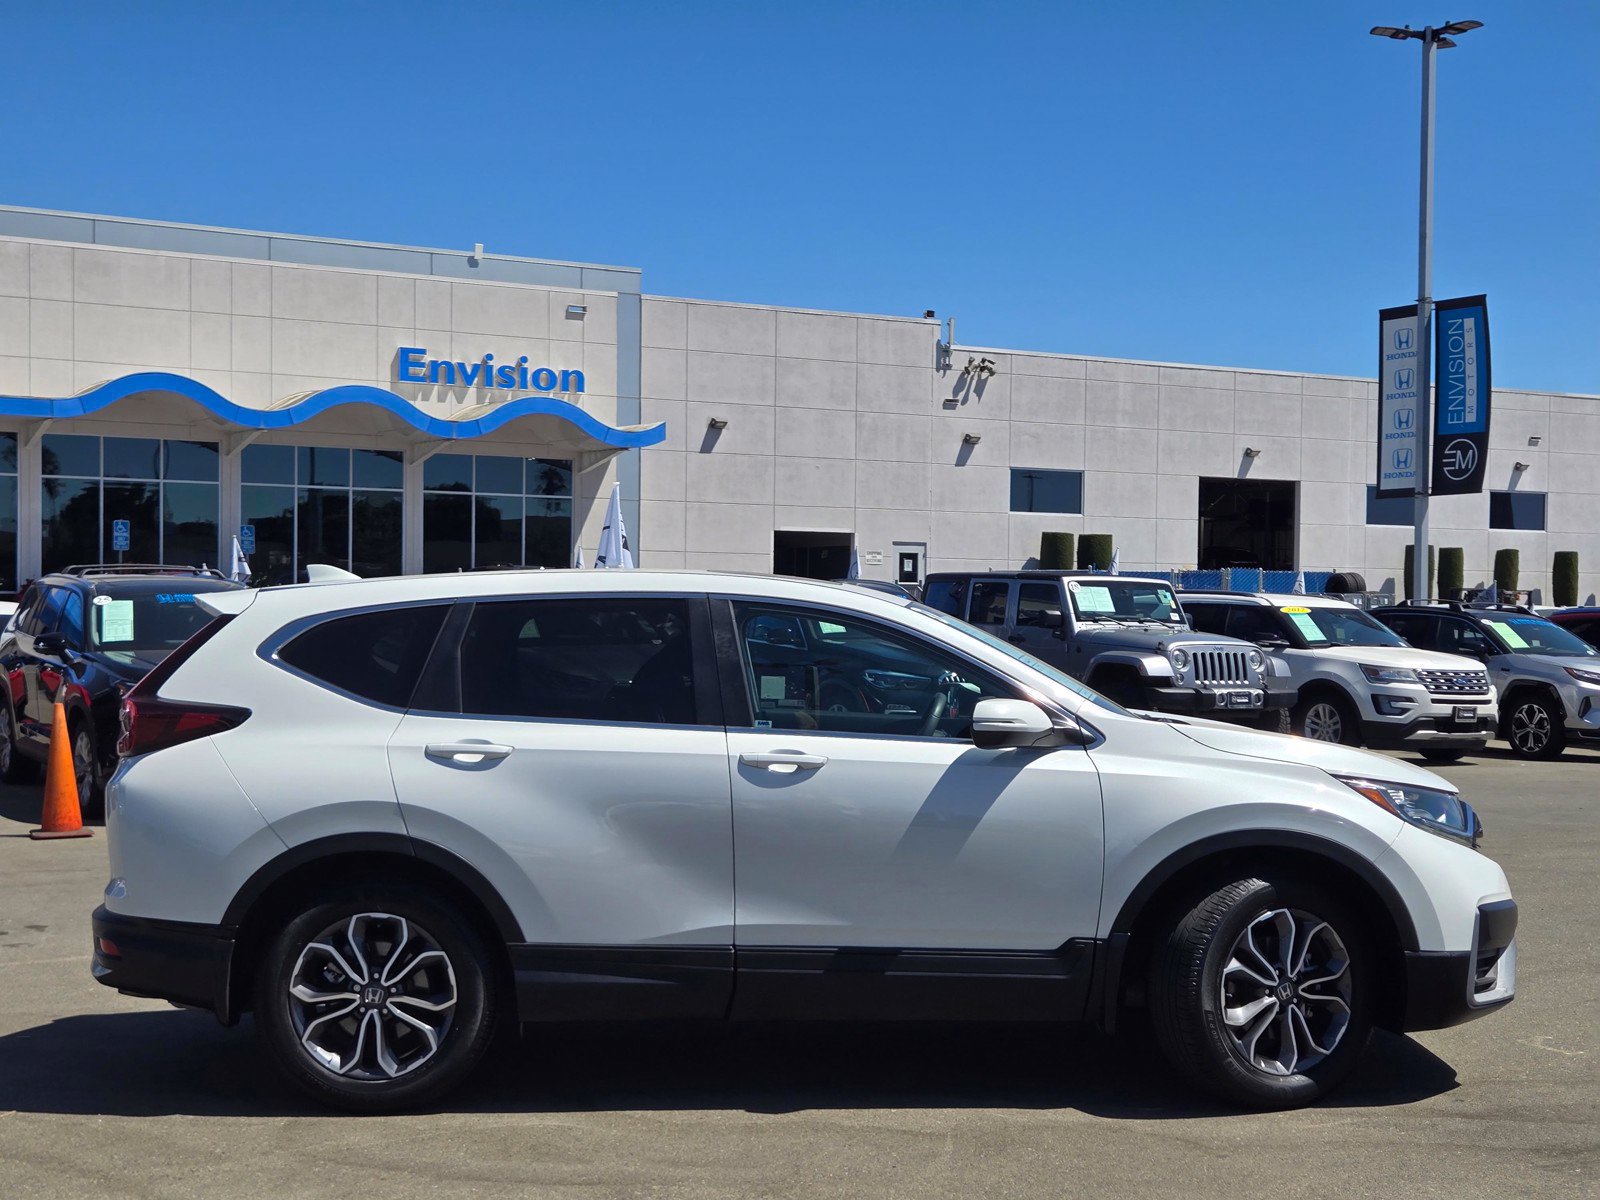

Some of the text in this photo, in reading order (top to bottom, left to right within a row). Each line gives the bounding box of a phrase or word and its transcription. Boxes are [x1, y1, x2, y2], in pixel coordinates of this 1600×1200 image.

[398, 347, 586, 393] Envision
[1447, 319, 1464, 425] ENVISION
[1466, 327, 1475, 414] MOTORS
